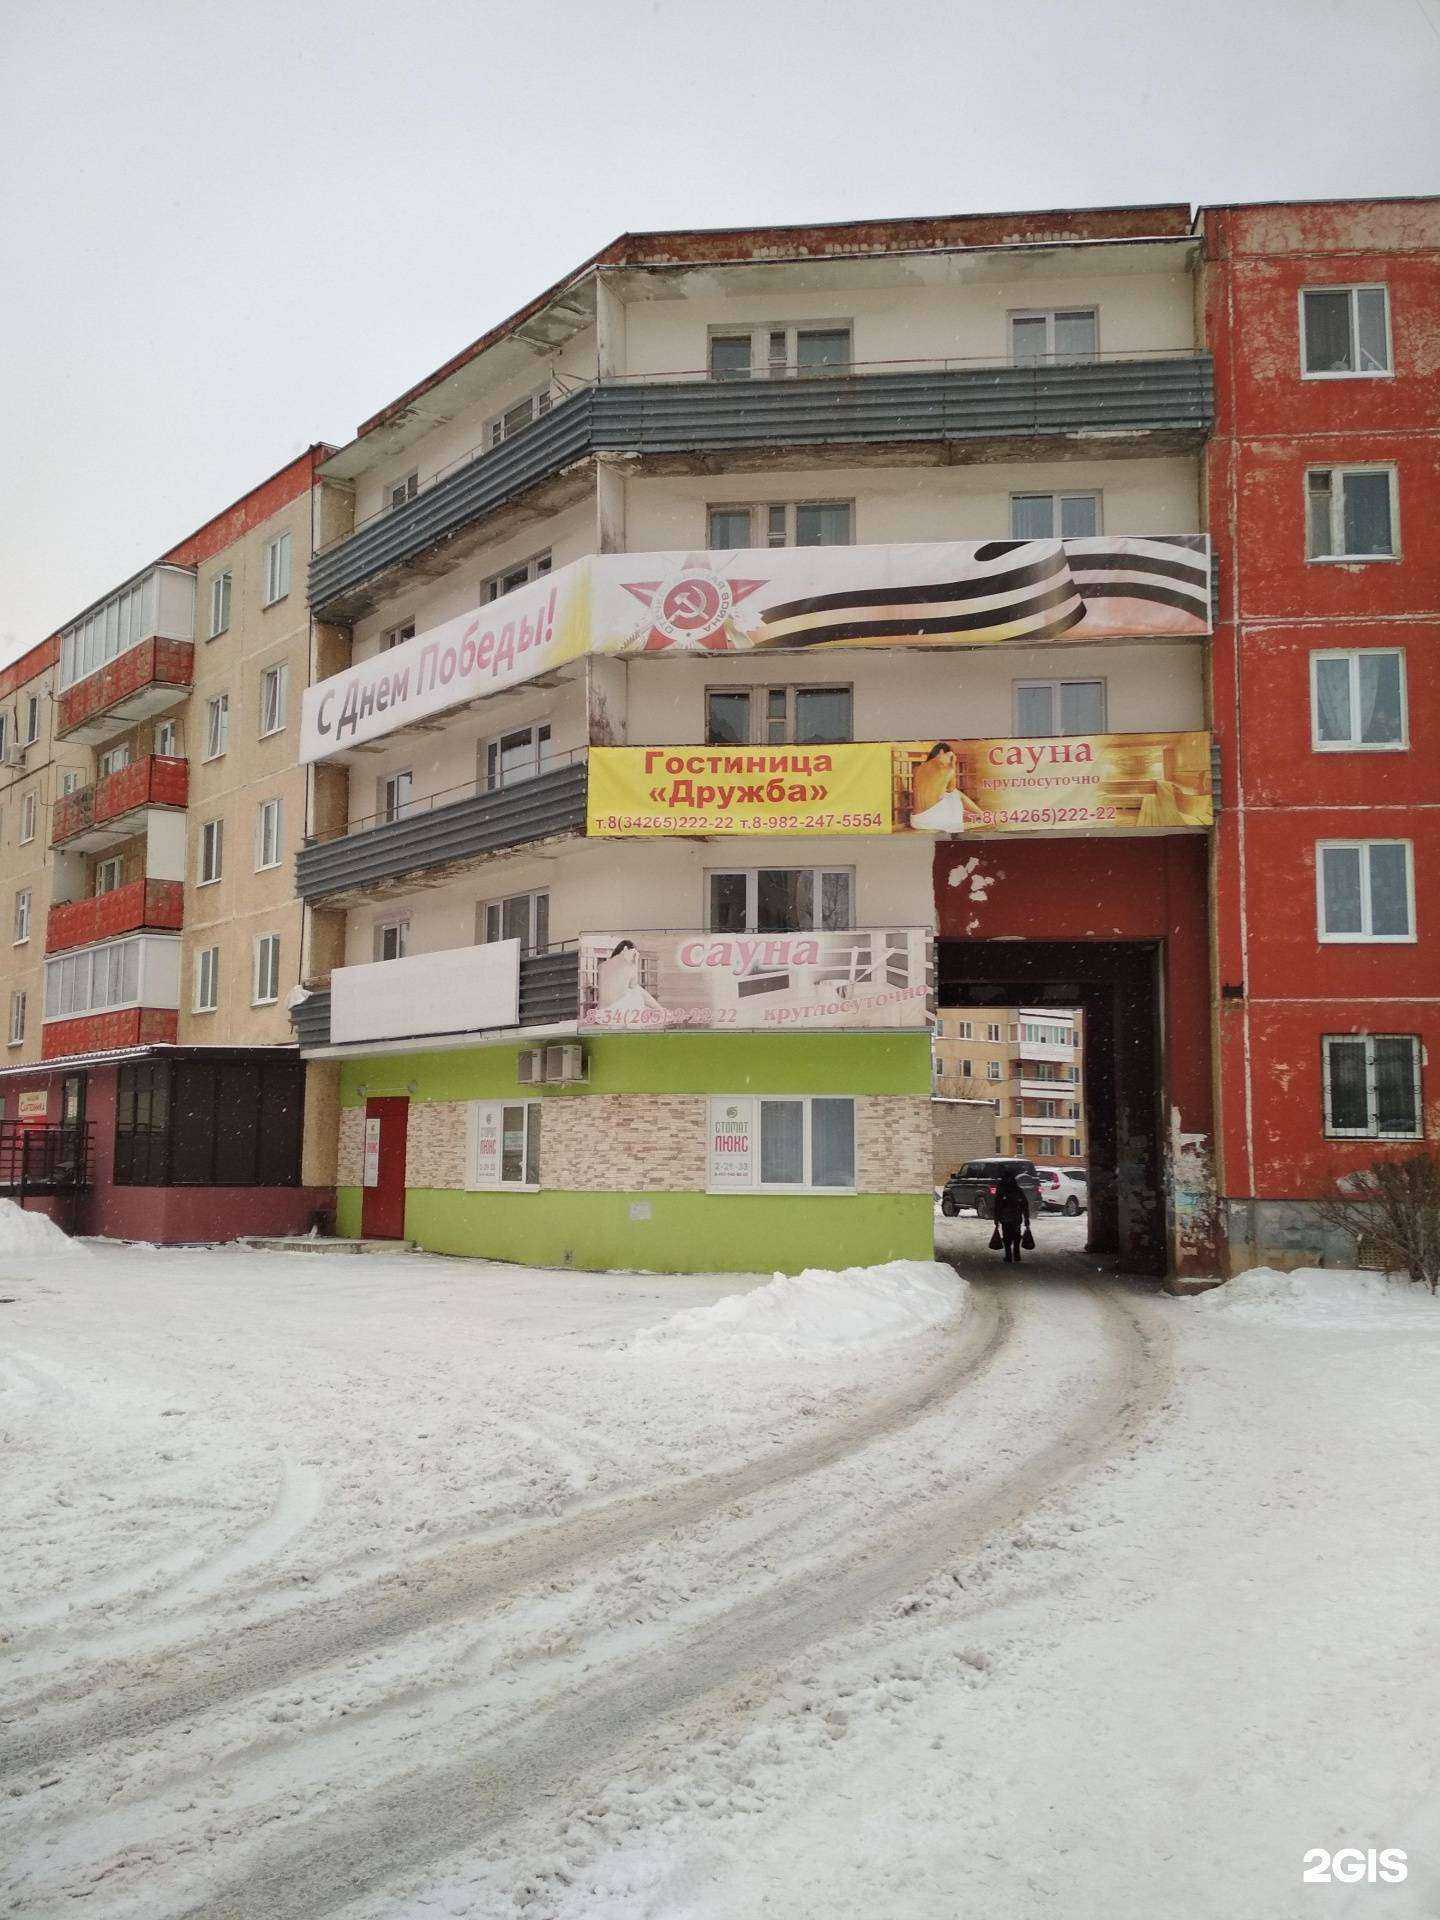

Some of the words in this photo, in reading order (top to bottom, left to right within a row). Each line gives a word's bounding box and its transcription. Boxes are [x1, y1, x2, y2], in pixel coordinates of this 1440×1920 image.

[317, 689, 336, 736] С
[336, 667, 411, 741] Днем
[416, 587, 559, 696] Победы!
[644, 751, 833, 776] Гостиница
[988, 742, 1095, 773] сауна
[649, 779, 829, 810] «Дружба»
[983, 775, 1101, 790] круглосуточно
[680, 940, 819, 976] сауна
[764, 985, 929, 1024] круглосуточно
